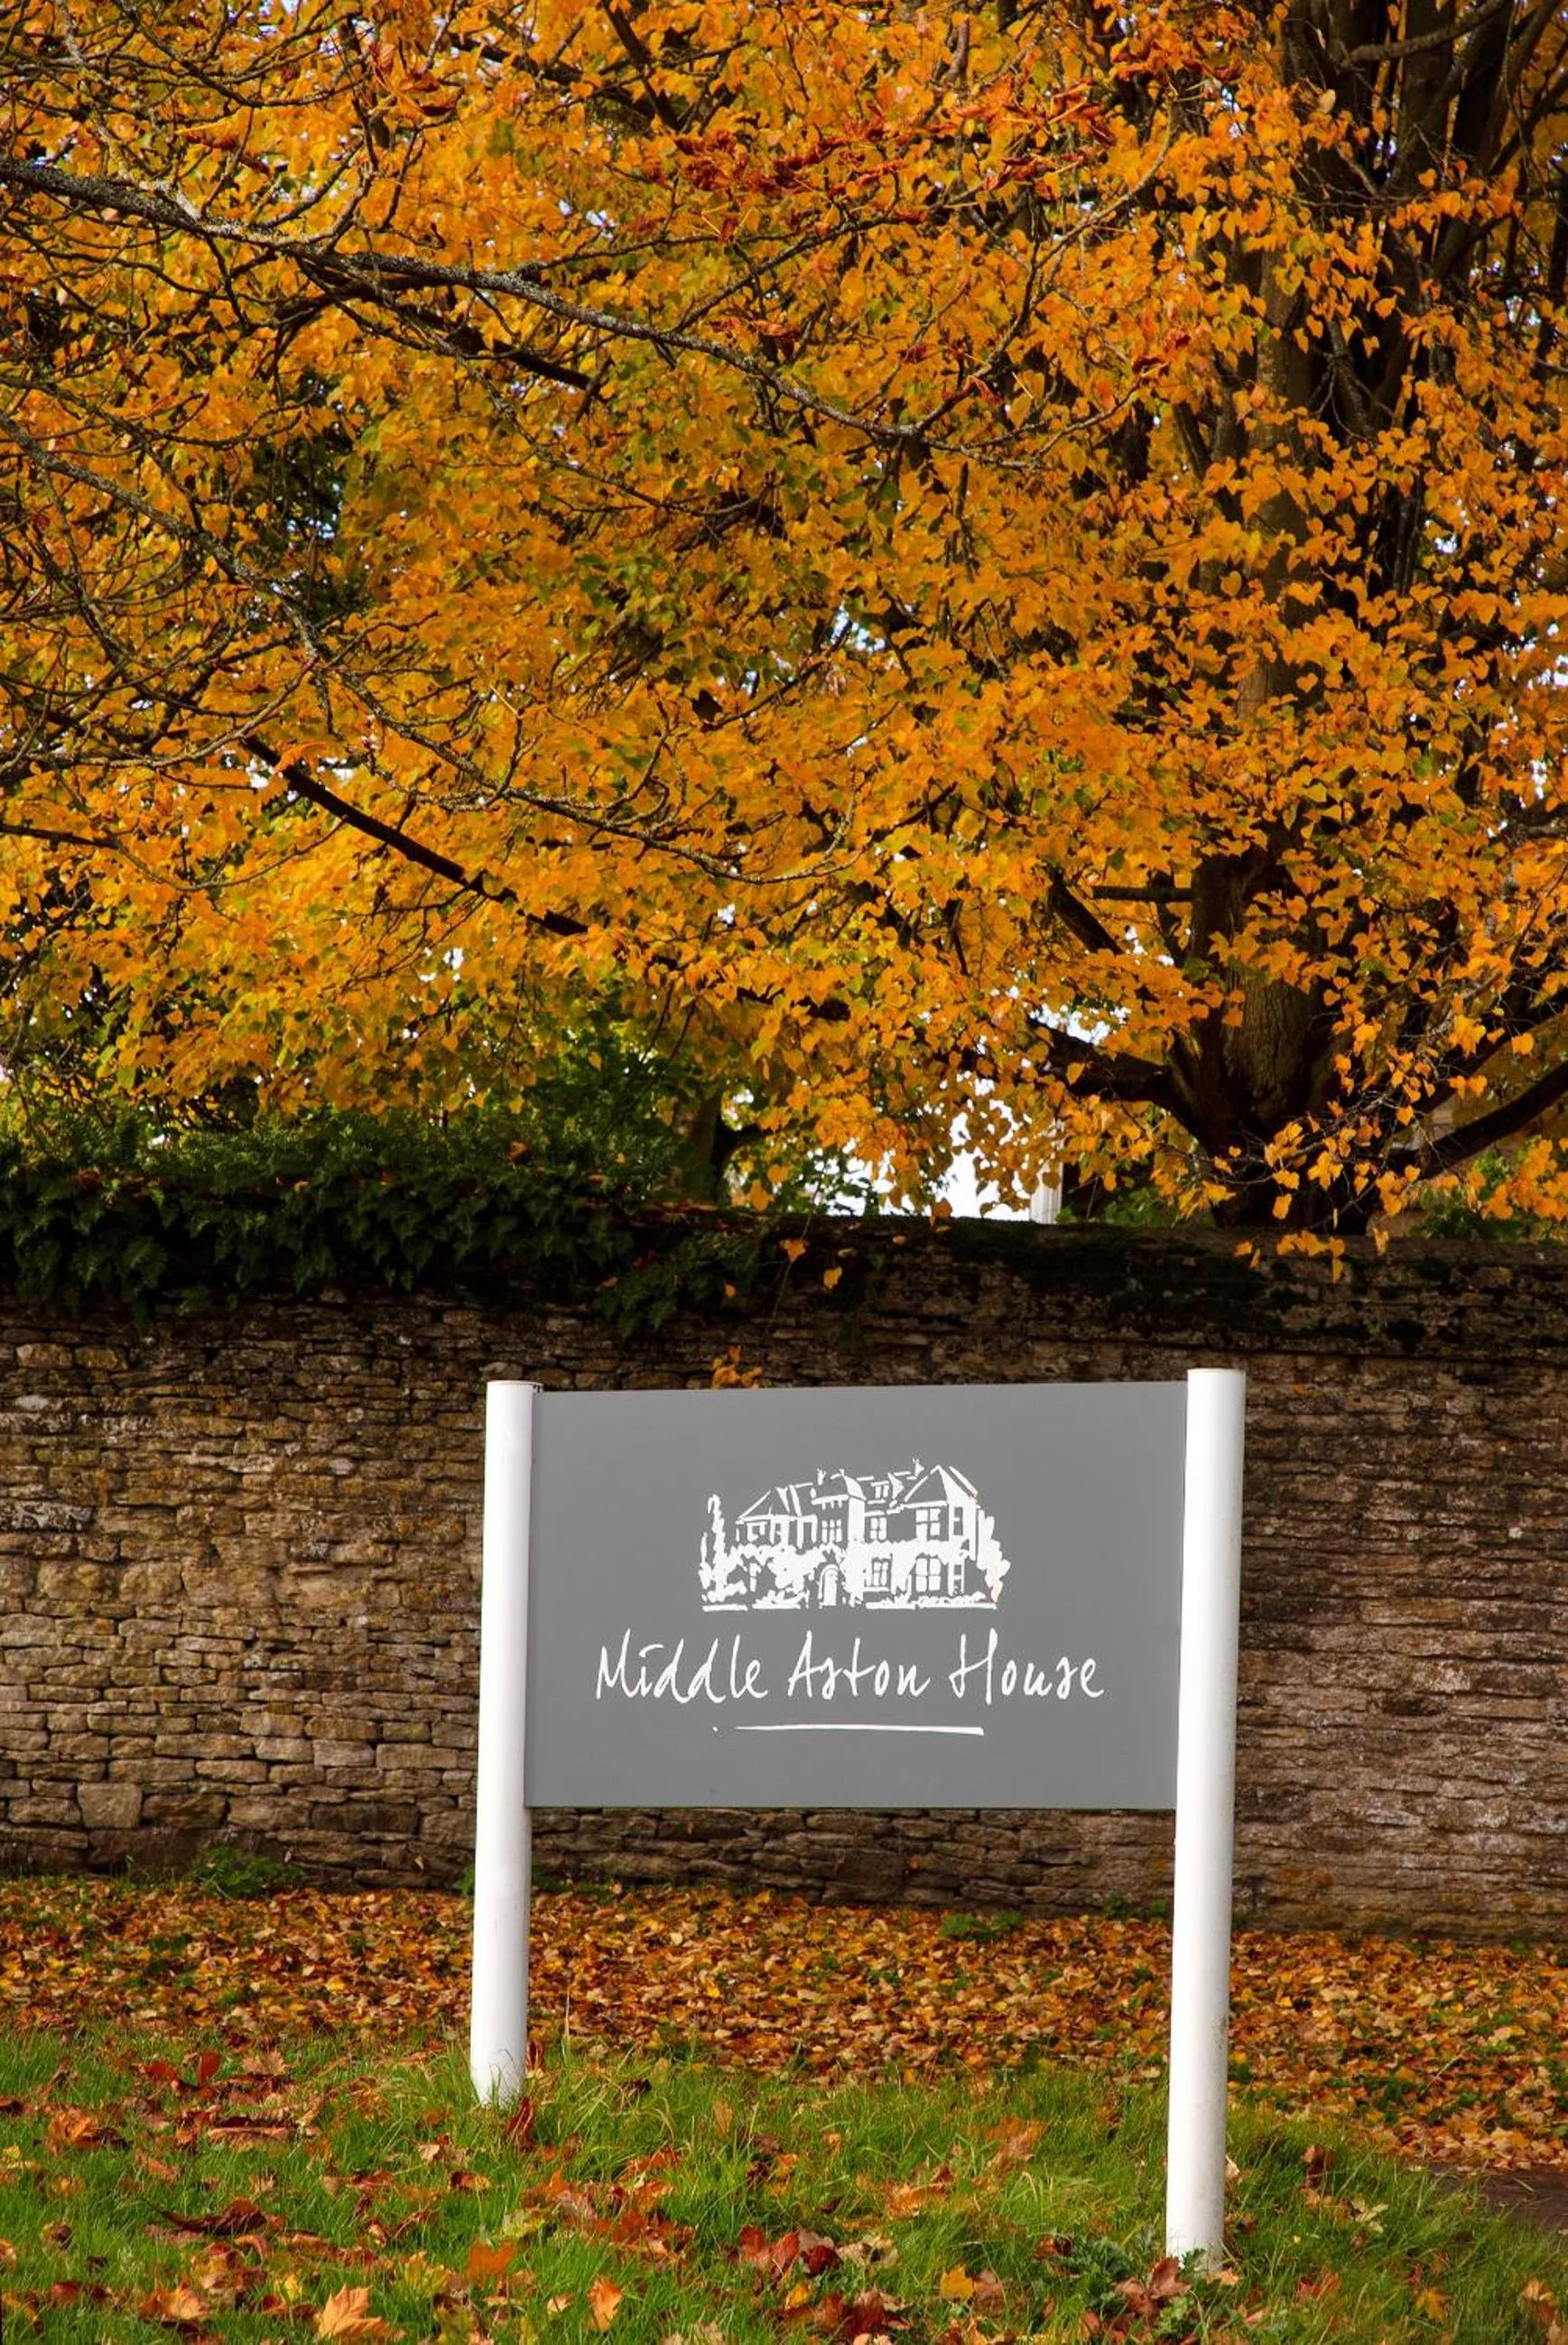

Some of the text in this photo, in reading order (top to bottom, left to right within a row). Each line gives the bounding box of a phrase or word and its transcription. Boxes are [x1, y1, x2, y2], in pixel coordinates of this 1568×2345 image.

[596, 1627, 1105, 1705] Middle Aston House
